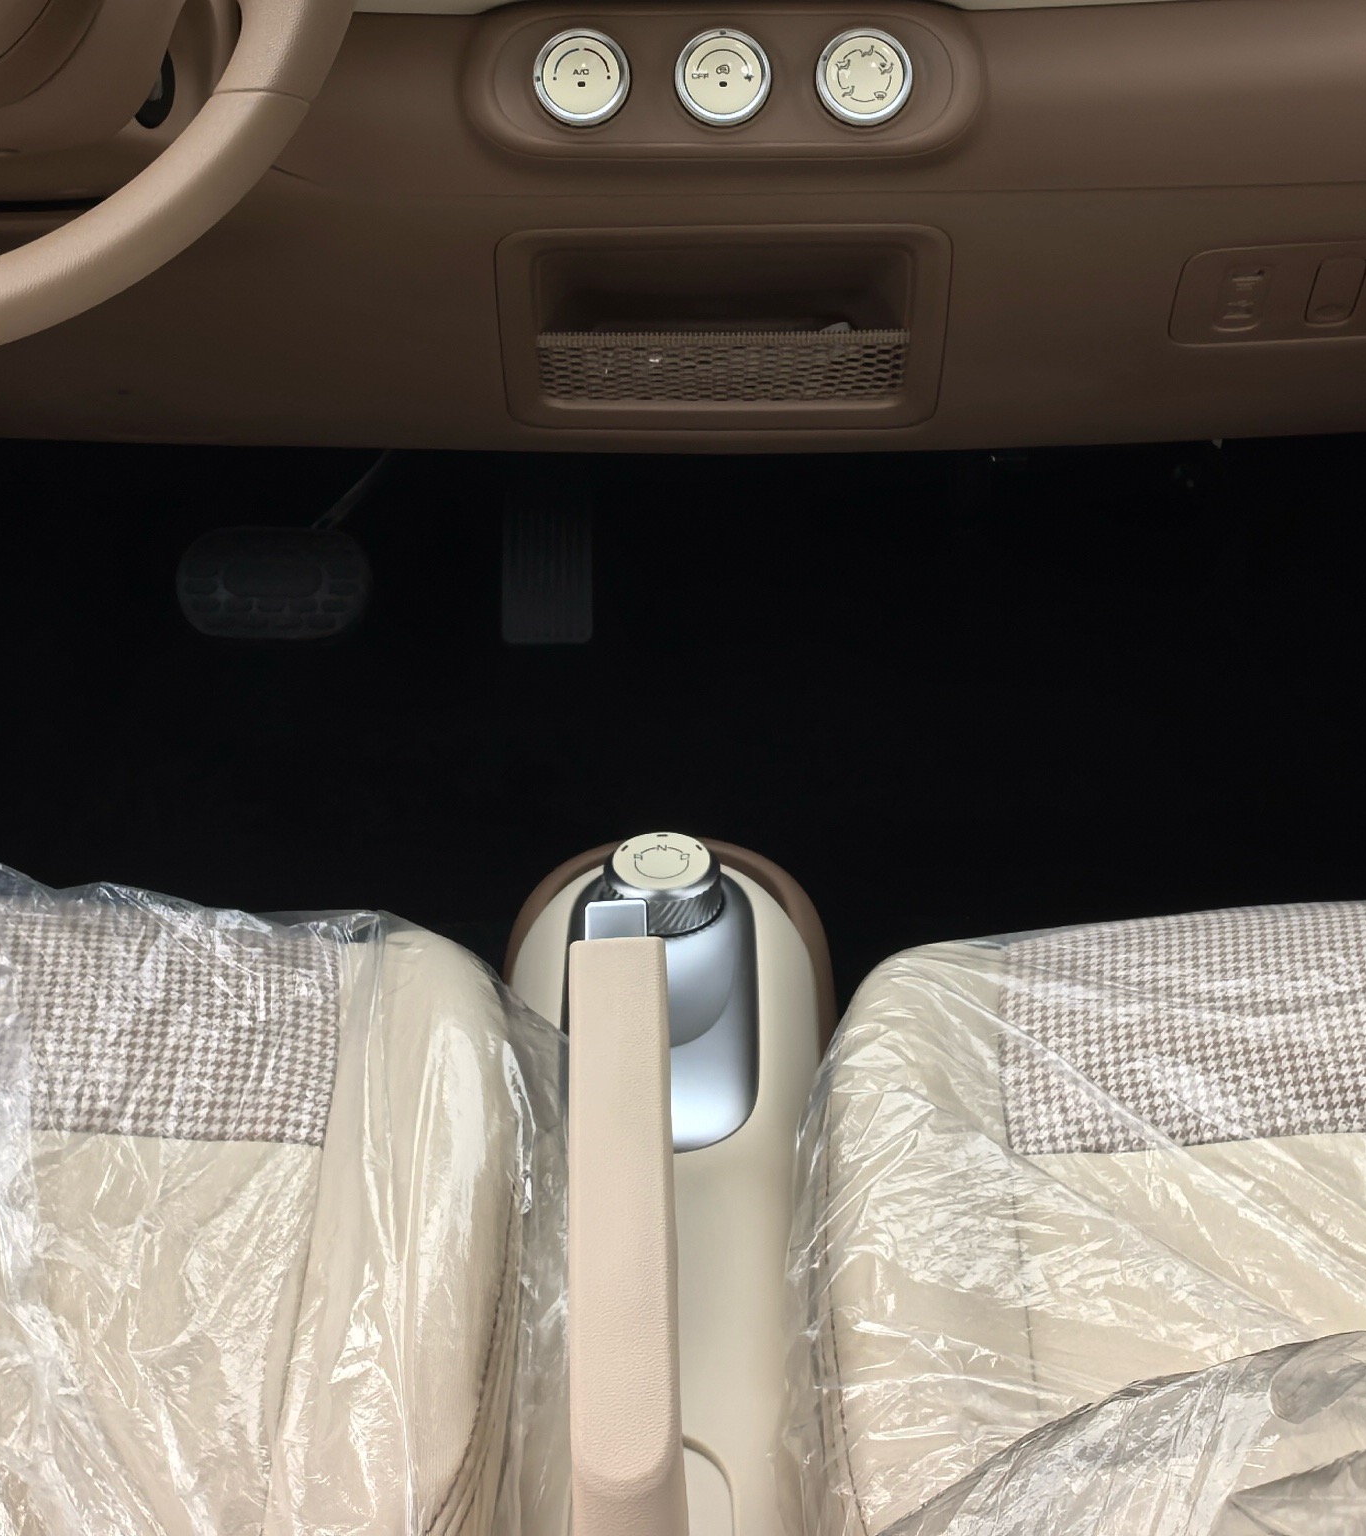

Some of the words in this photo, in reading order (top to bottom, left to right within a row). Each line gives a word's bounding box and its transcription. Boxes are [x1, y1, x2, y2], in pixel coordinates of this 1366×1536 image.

[572, 68, 590, 76] A/C
[691, 72, 709, 80] OFF
[656, 844, 668, 852] N
